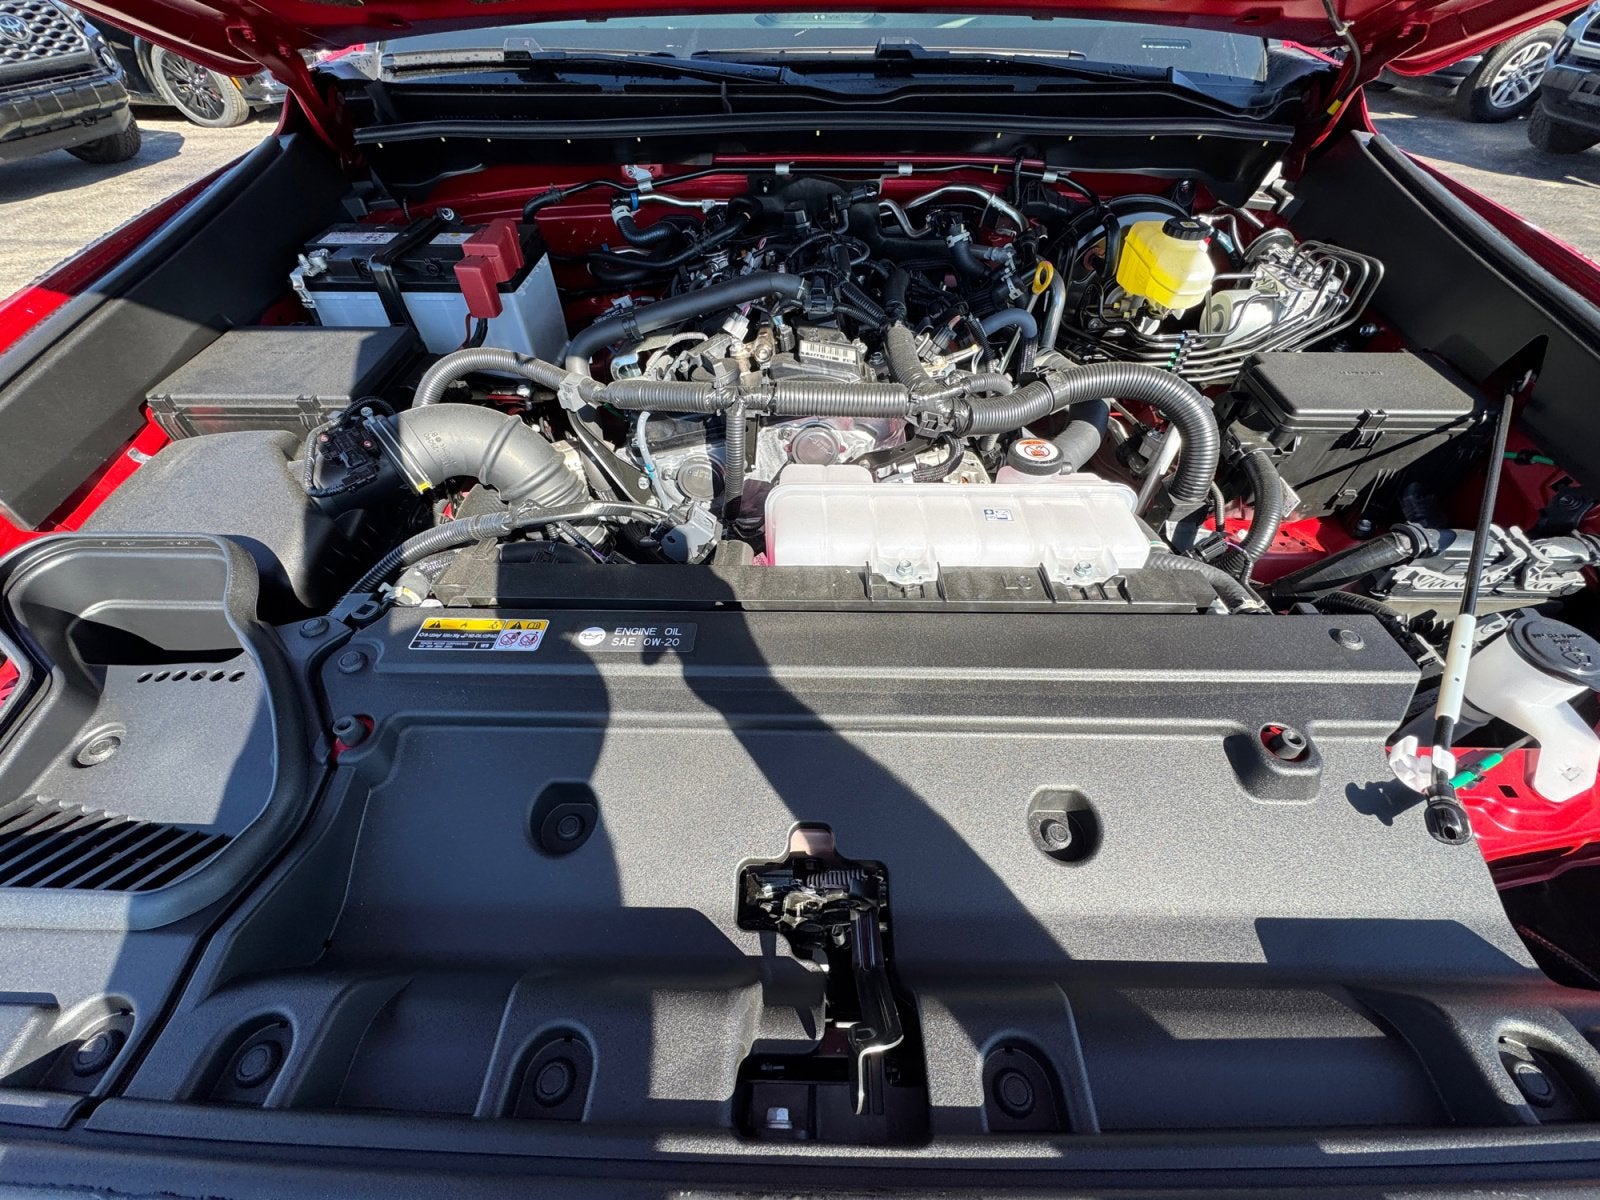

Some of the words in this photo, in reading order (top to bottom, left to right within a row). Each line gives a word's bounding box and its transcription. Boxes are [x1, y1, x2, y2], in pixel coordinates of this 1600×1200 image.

[614, 627, 657, 636] ENGINE
[664, 627, 682, 636] OIL
[611, 637, 636, 647] SAE
[643, 637, 680, 647] 0W-20
